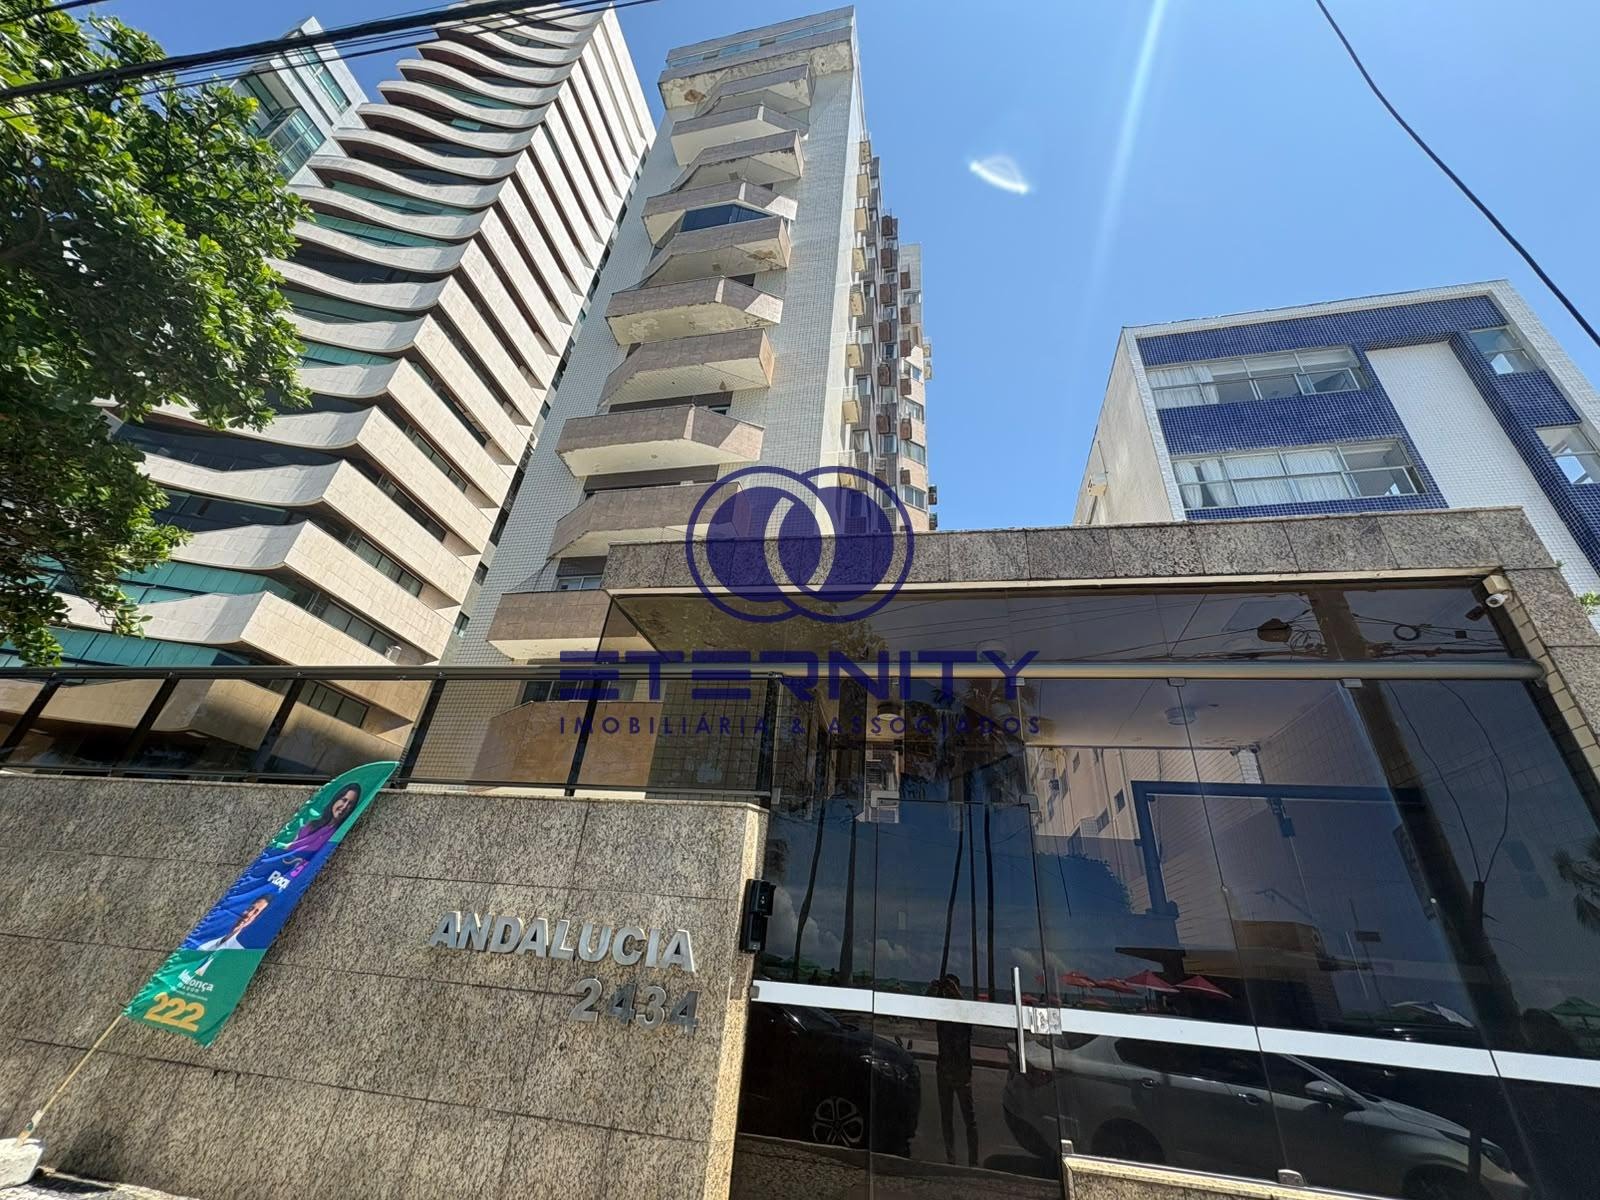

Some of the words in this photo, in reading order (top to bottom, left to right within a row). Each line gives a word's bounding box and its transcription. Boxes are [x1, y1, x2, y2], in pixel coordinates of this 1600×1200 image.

[429, 910, 696, 972] ANDALUCIA
[143, 992, 205, 1032] 222
[569, 977, 699, 1036] 2434
